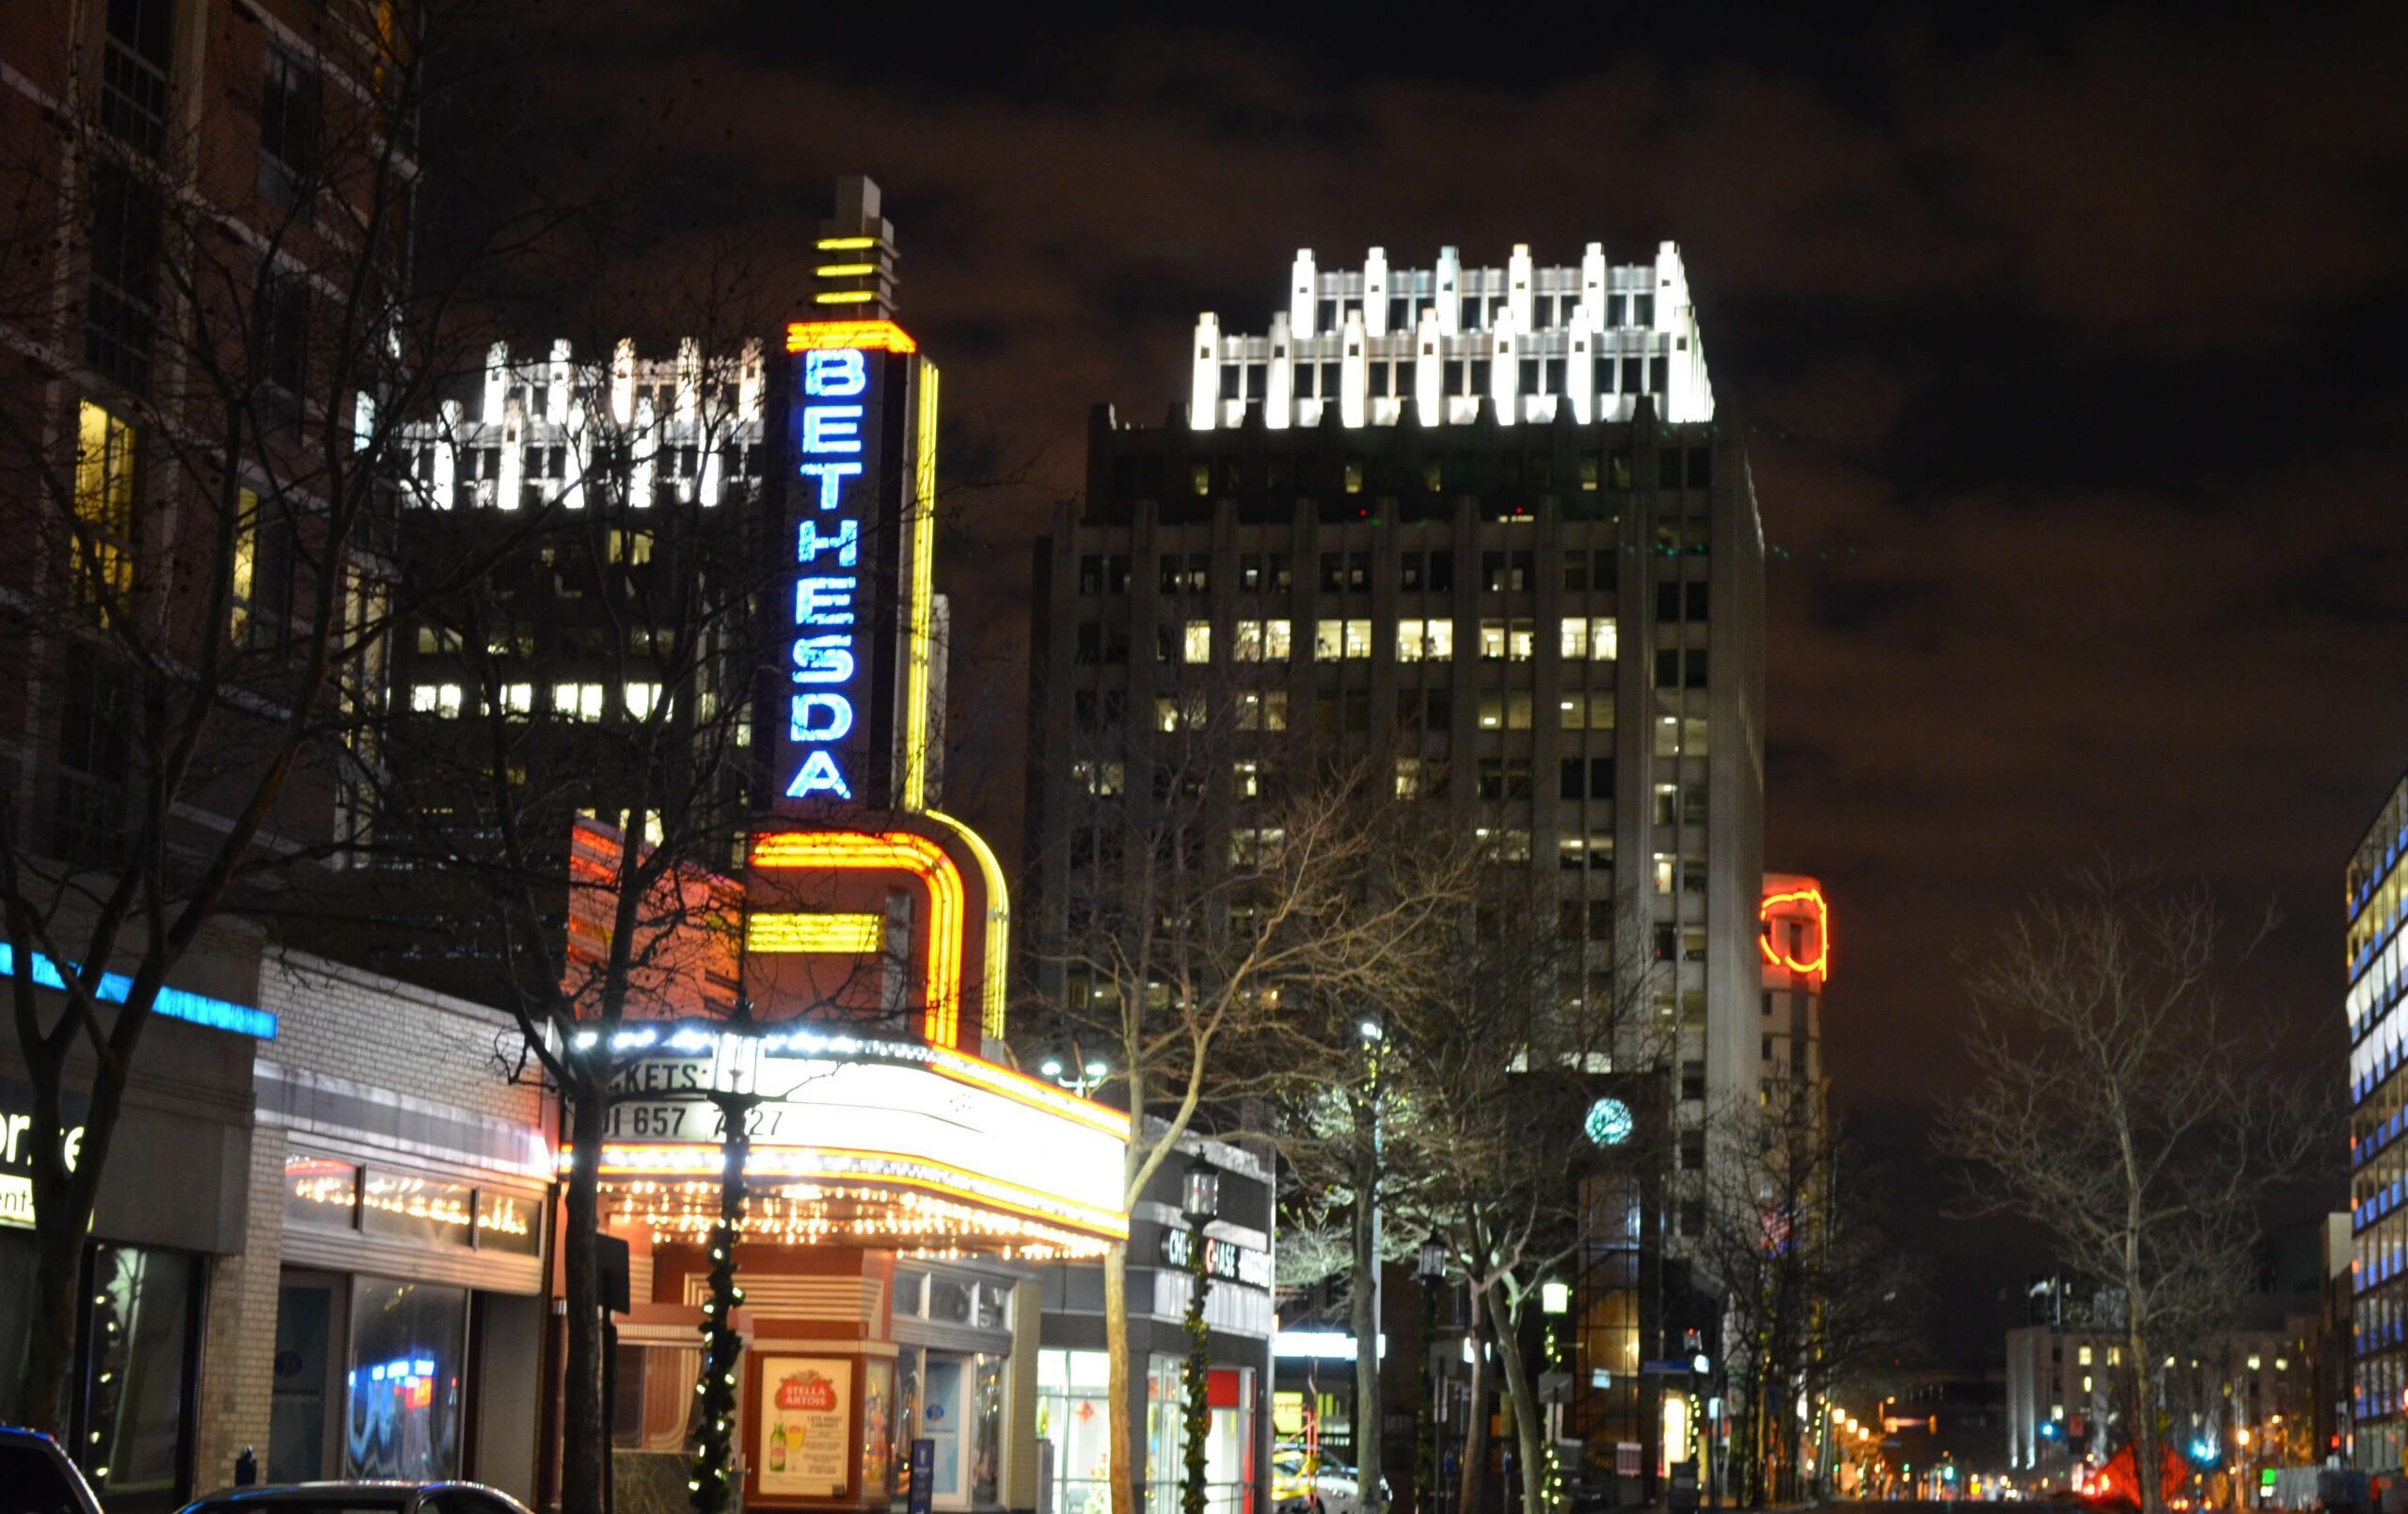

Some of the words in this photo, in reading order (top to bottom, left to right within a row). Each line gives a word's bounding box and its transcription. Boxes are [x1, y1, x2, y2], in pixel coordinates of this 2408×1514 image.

[785, 348, 867, 800] BETHESDA
[633, 1107, 687, 1136] 657
[713, 1109, 784, 1136] 727
[1205, 1237, 1236, 1278] CHASE
[784, 1396, 826, 1406] ARTOIS
[785, 1385, 826, 1396] STELLA
